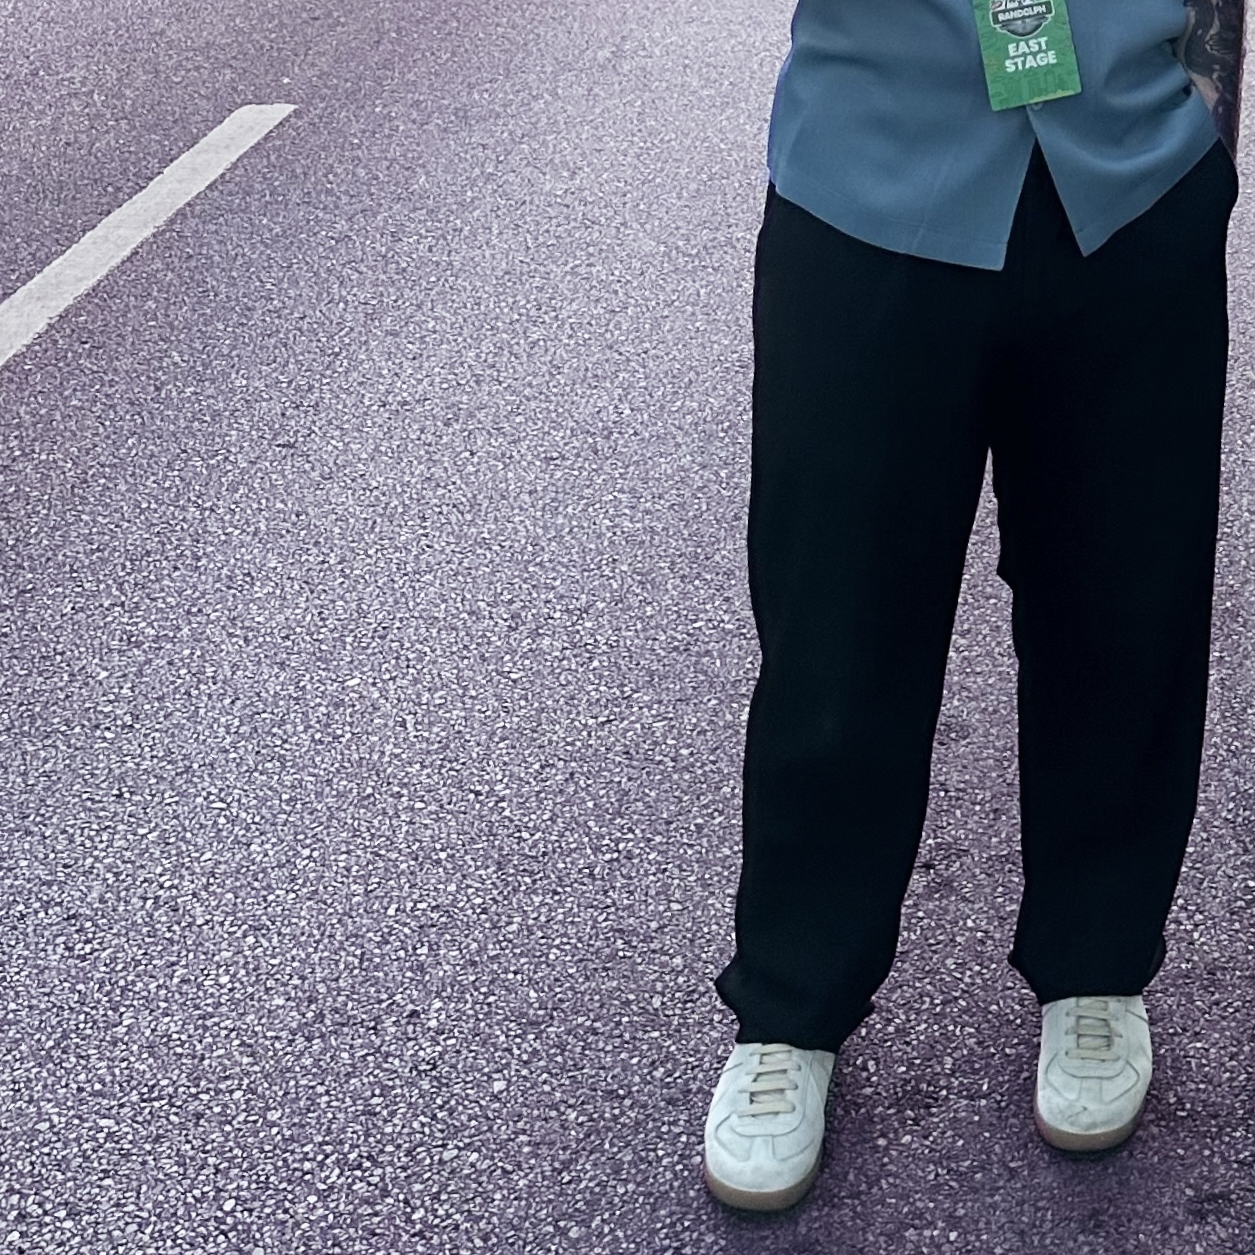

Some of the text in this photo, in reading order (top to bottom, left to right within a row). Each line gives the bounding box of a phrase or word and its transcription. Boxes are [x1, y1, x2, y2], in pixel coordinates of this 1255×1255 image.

[997, 5, 1047, 21] RANDOLPH
[1007, 37, 1048, 57] EAST
[1005, 51, 1058, 73] STAGE
